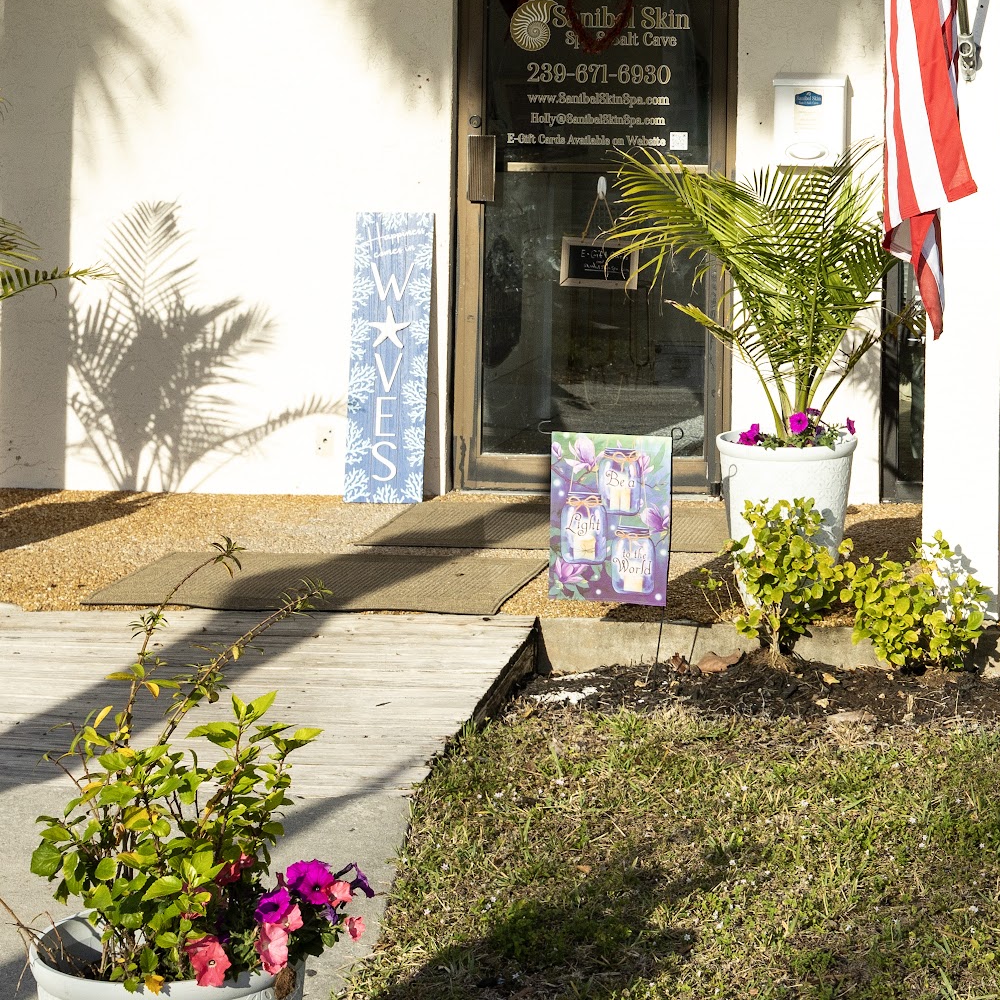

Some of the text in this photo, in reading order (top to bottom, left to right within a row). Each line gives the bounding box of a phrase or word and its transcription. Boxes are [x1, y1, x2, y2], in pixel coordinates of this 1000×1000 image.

[552, 4, 691, 30] Snibl Skin
[565, 30, 587, 49] Sp
[612, 31, 640, 47] alt
[642, 31, 678, 47] Cave
[526, 62, 672, 85] 239-671-6930
[527, 91, 671, 108] www.SanibelSkinSpa.com
[530, 112, 666, 128] Holly@SanibelSkinSpa.com
[506, 132, 667, 147] E-Gift Cards Available on Website
[369, 261, 415, 483] WVES
[605, 469, 636, 488] Be a
[565, 512, 601, 537] Light
[622, 549, 647, 559] to the
[612, 557, 652, 576] World
